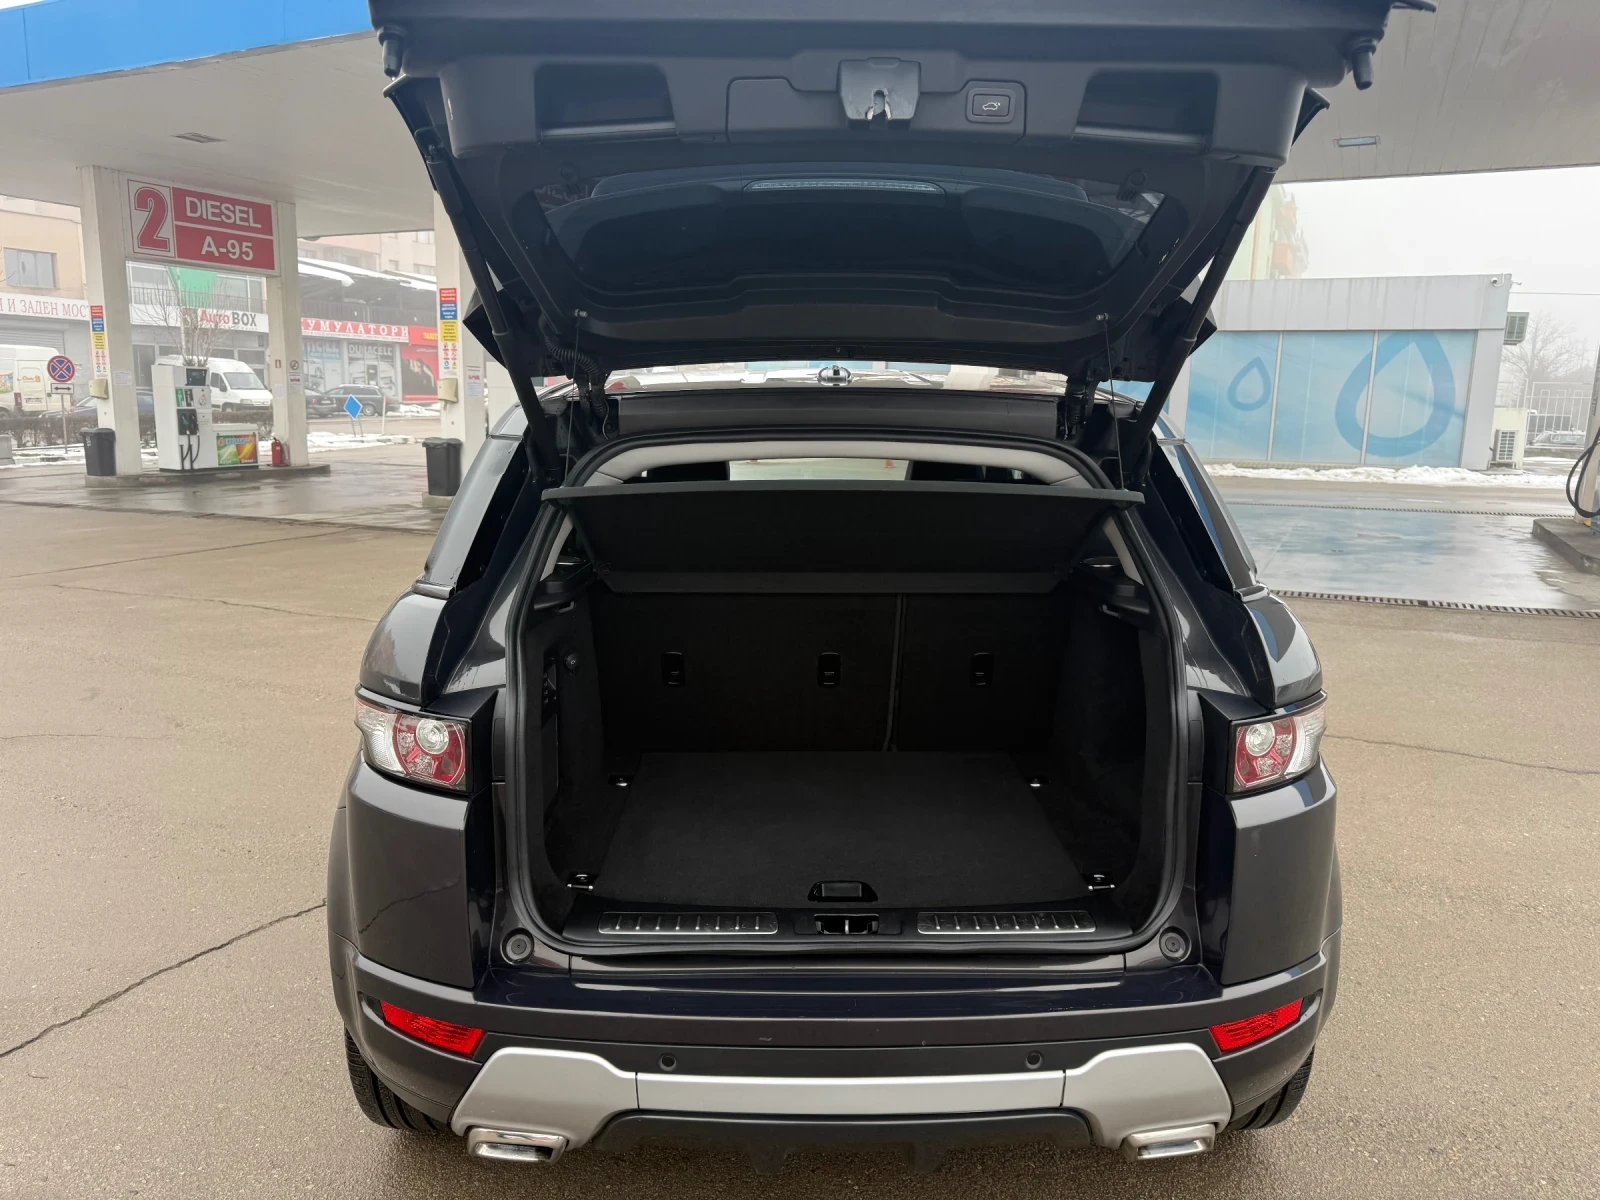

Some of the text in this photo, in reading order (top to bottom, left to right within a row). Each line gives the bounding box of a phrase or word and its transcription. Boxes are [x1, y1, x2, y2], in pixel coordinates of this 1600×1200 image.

[134, 187, 170, 252] 2
[185, 196, 262, 229] DIESEL
[200, 235, 254, 261] A-95
[8, 299, 16, 312] И
[20, 299, 58, 316] ЗАДЕН
[62, 303, 89, 317] МОС
[232, 311, 257, 327] BOX
[301, 319, 409, 337] УМУЛАТОРИ
